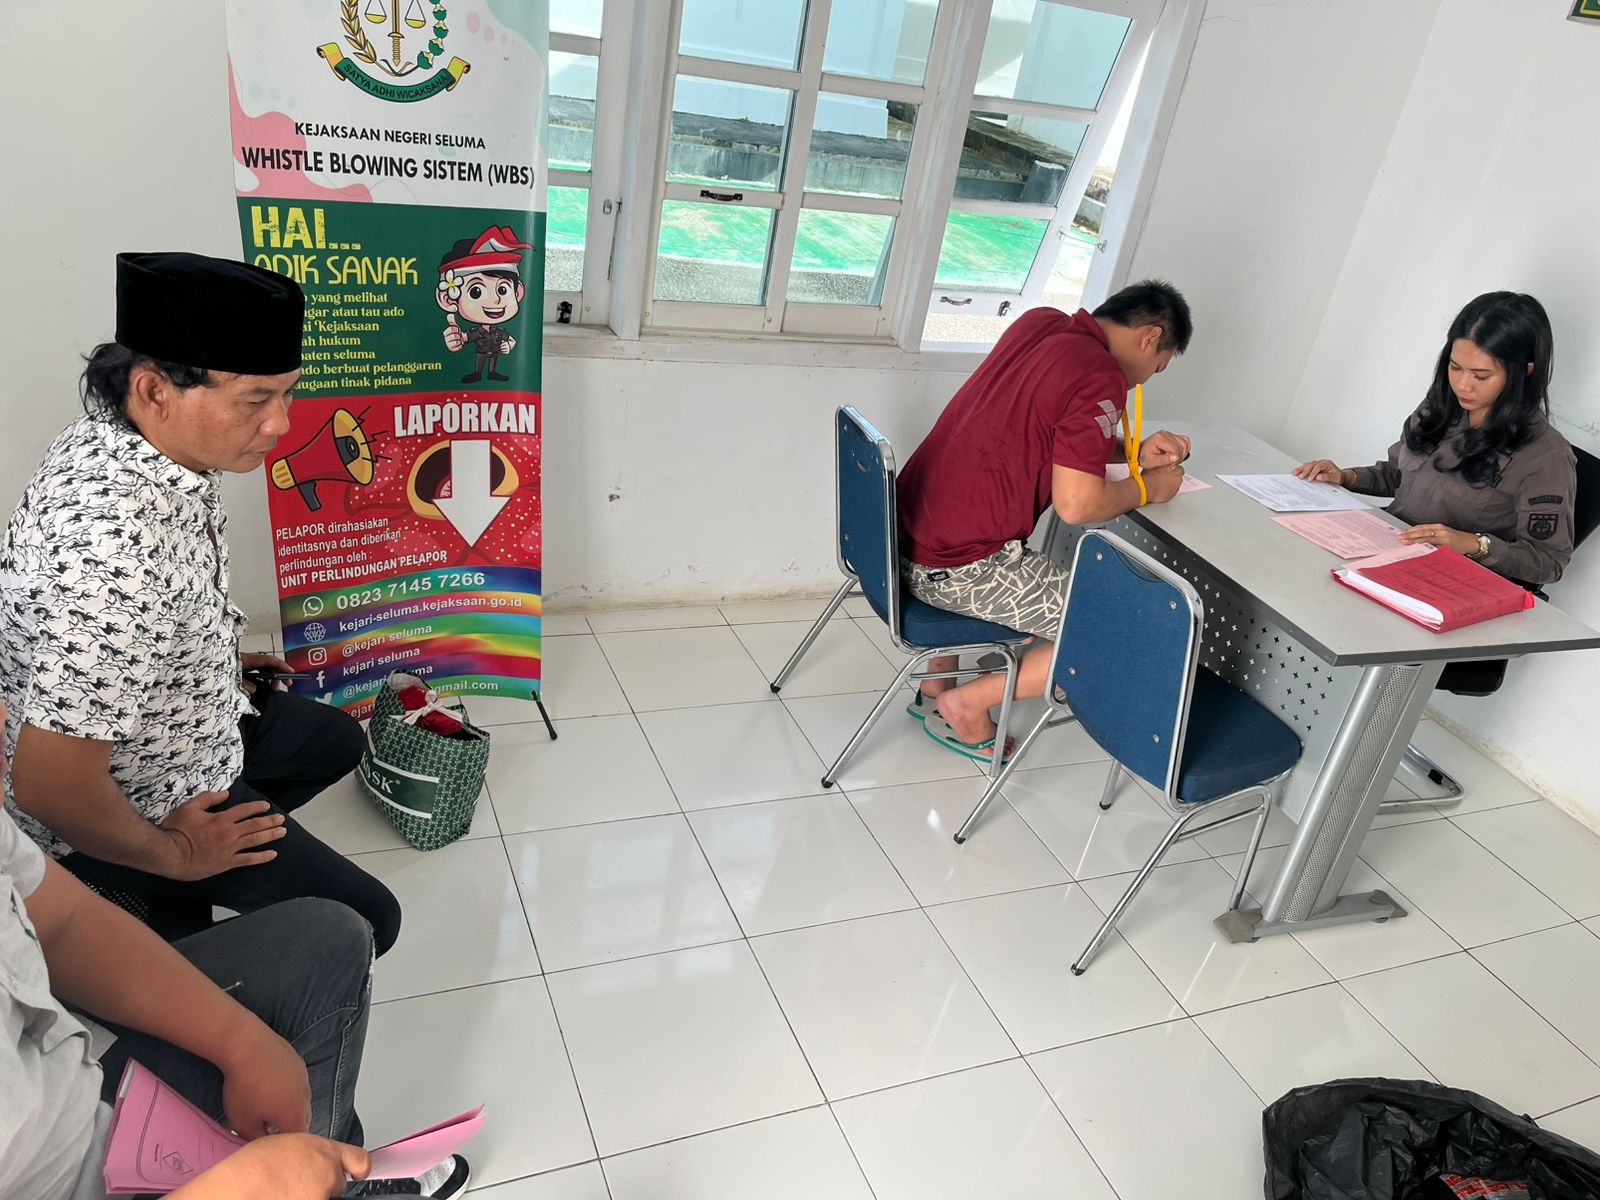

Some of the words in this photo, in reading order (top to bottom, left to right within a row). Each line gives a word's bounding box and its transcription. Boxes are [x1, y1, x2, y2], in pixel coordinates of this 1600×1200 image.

[343, 63, 372, 90] SATYA
[372, 85, 394, 98] ADHI
[397, 74, 449, 99] WICAKSANA
[294, 122, 381, 142] KEJAKSAAN
[384, 131, 432, 146] NEGERI
[434, 134, 486, 150] SELUMA
[241, 146, 324, 172] WHISTLE
[329, 153, 418, 178] BLOWING
[423, 157, 483, 183] SISTEM
[487, 163, 535, 189] (WBS)
[250, 205, 362, 250] HAI...
[328, 255, 418, 286] SANAK
[310, 292, 341, 305] yang
[343, 291, 388, 303] melihat
[332, 307, 359, 317] atau
[361, 307, 381, 317] tau
[383, 306, 405, 317] ado
[314, 319, 380, 334] Kejaksaan
[319, 335, 361, 346] hukum
[323, 363, 370, 375] berbuat
[373, 361, 442, 376] pelanggaran
[333, 349, 376, 360] seluma
[340, 376, 371, 388] tinak
[373, 375, 412, 389] pidana
[393, 403, 536, 437] LAPORKAN
[275, 522, 326, 542] PELAPOR
[328, 517, 389, 534] dirahasiakan
[277, 538, 338, 558] identitasnya
[340, 535, 359, 549] dan
[361, 529, 402, 546] diberikan
[279, 553, 345, 576] perlindungan
[347, 550, 367, 563] oleh
[280, 572, 308, 589] UNIT
[311, 557, 398, 583] PERLINDUNGAN
[399, 550, 448, 568] PELAPOR
[336, 587, 383, 611] 0823
[387, 573, 432, 598] 7145
[438, 571, 486, 589] 7266
[339, 595, 523, 633] kejari-seluma.kejaksaan.go.id
[342, 633, 386, 658] @kejari
[389, 624, 433, 643] seluma
[343, 657, 375, 677] kejari
[377, 647, 421, 667] seluma
